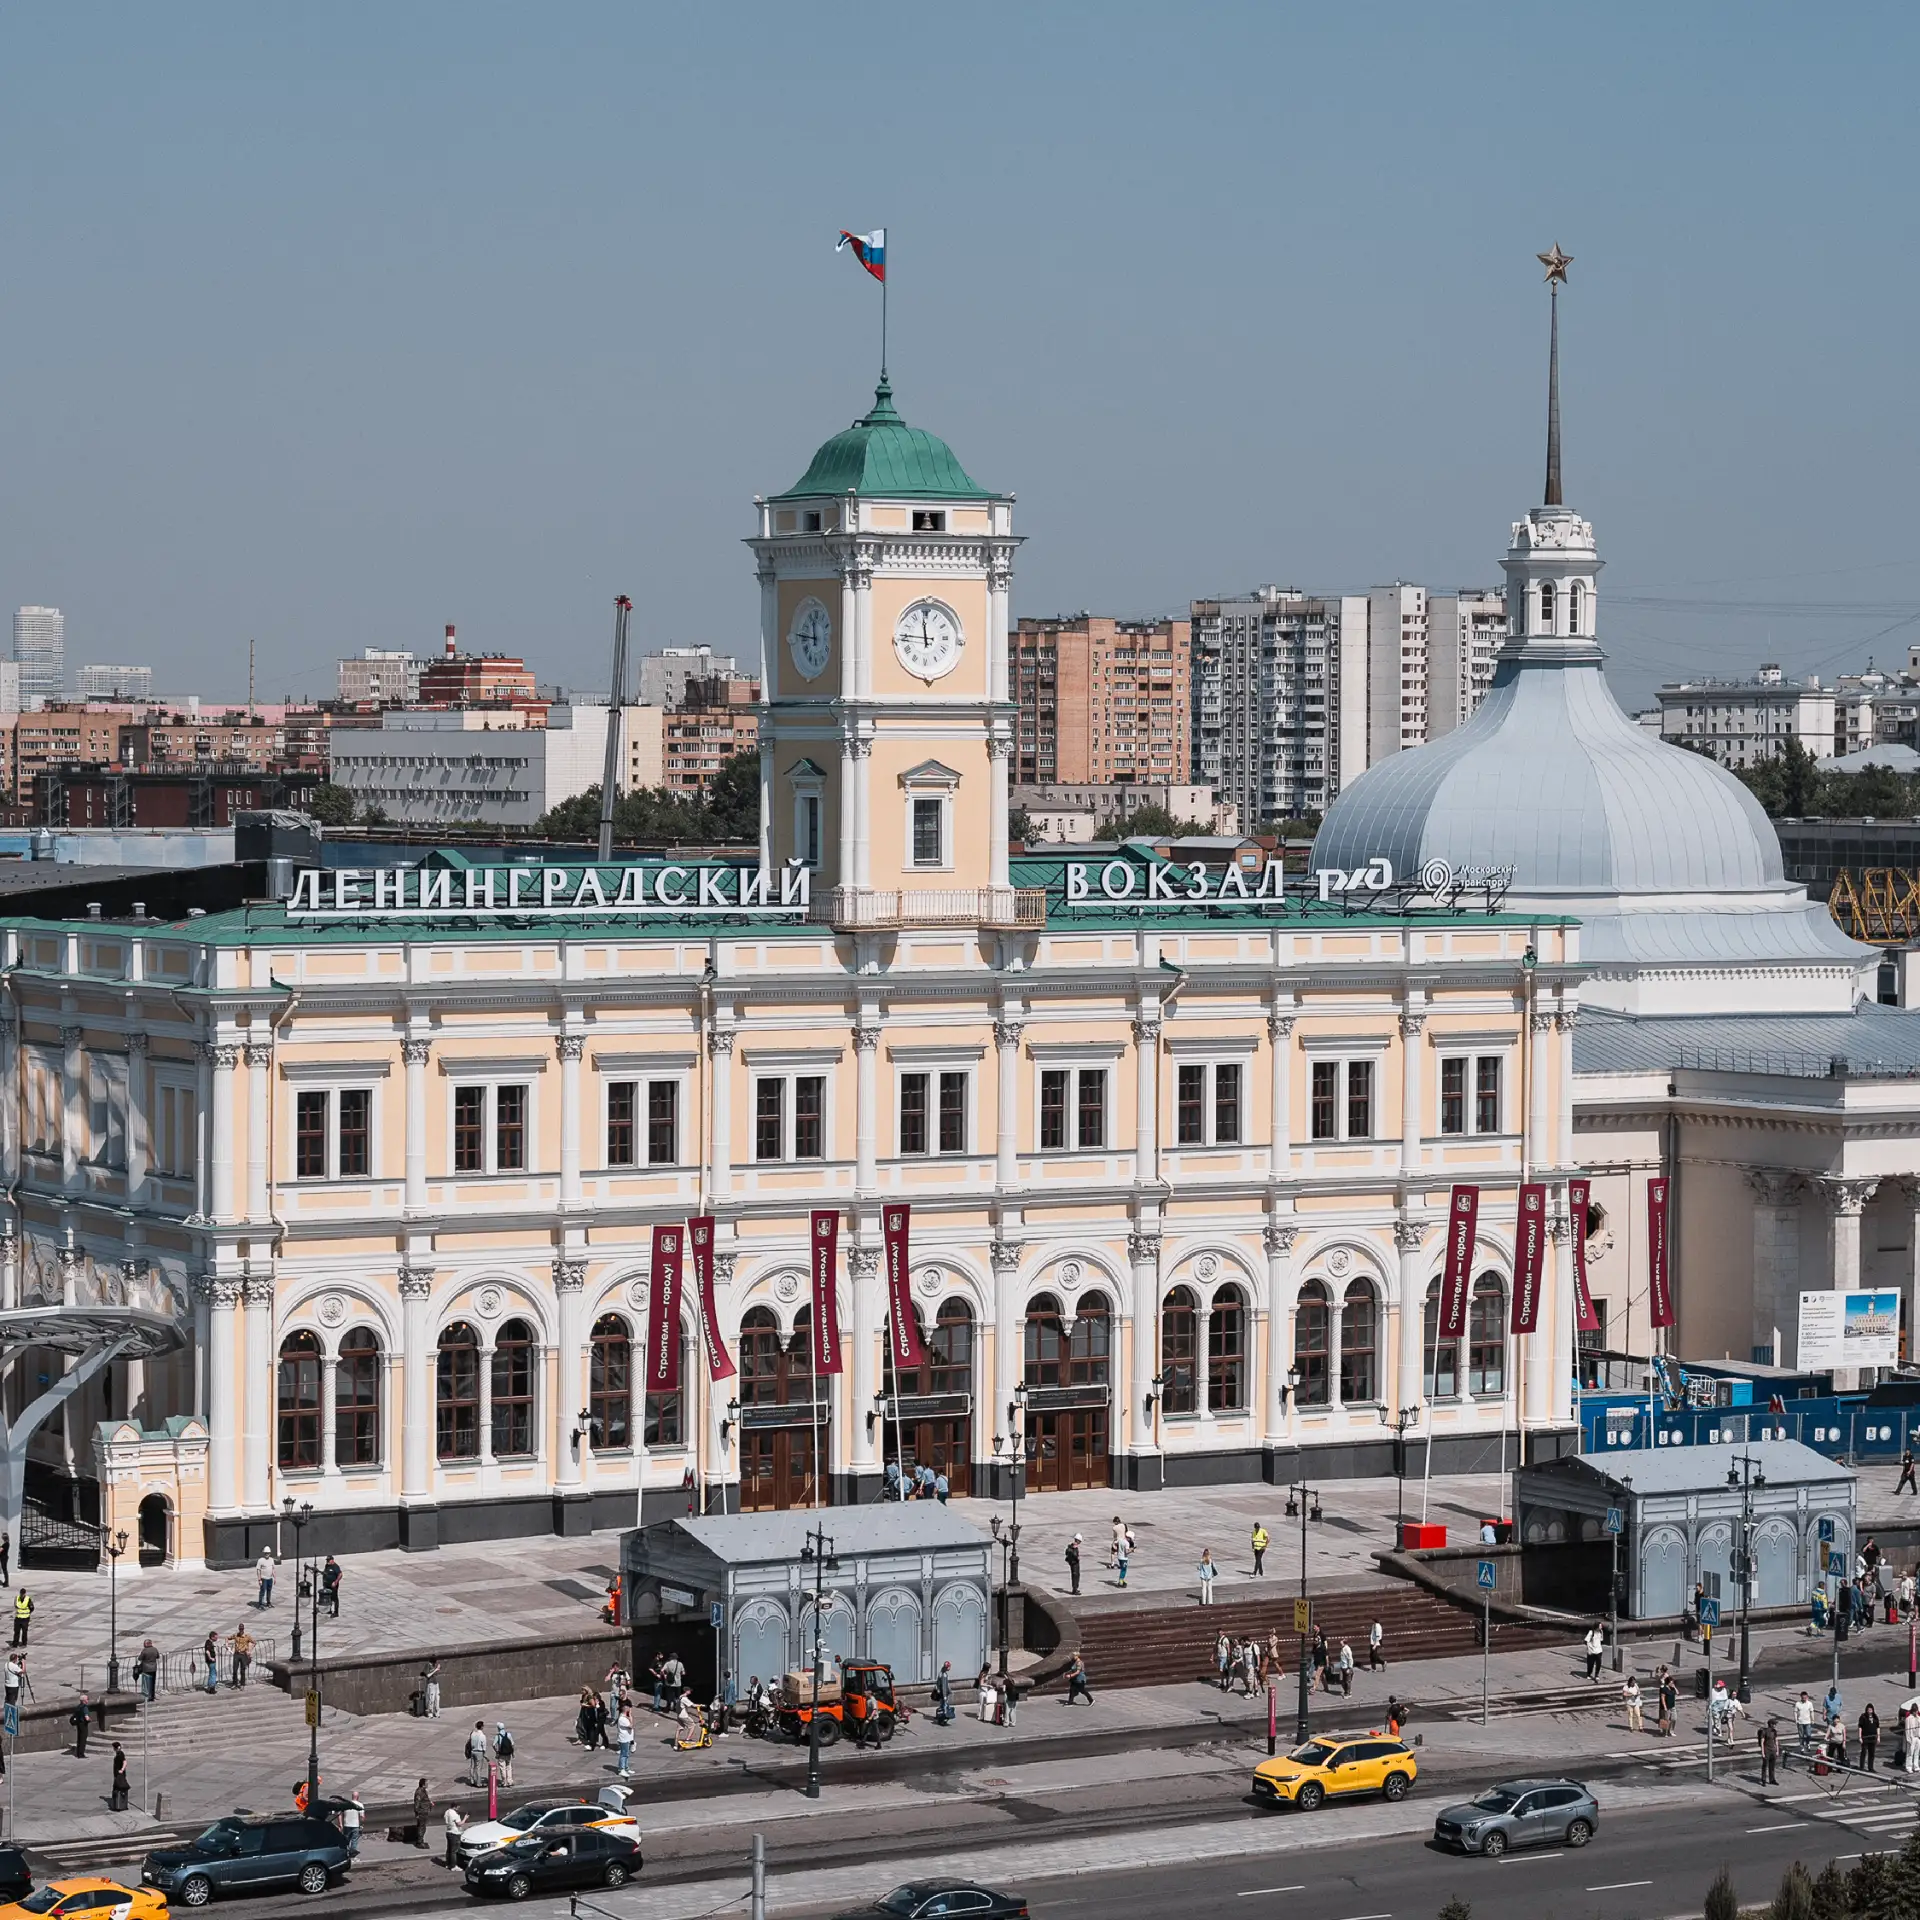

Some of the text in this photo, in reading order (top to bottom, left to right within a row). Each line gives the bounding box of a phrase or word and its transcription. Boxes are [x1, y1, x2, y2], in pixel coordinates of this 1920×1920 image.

[287, 858, 1284, 909] ЛЕНИНГРАДСКИЙ ВОКЗАЛ
[1460, 864, 1518, 874] Московский
[1460, 879, 1508, 889] транспорт
[662, 1263, 674, 1305] городу!
[818, 1247, 827, 1288] городу!
[890, 1241, 899, 1282] городу!
[1448, 1275, 1463, 1330] Строители
[1456, 1220, 1467, 1261] городу!
[1519, 1272, 1533, 1325] Строители
[1527, 1219, 1537, 1259] городу!
[658, 1321, 669, 1379] Строители
[820, 1303, 831, 1364] Строители
[893, 1298, 910, 1357] Строители
